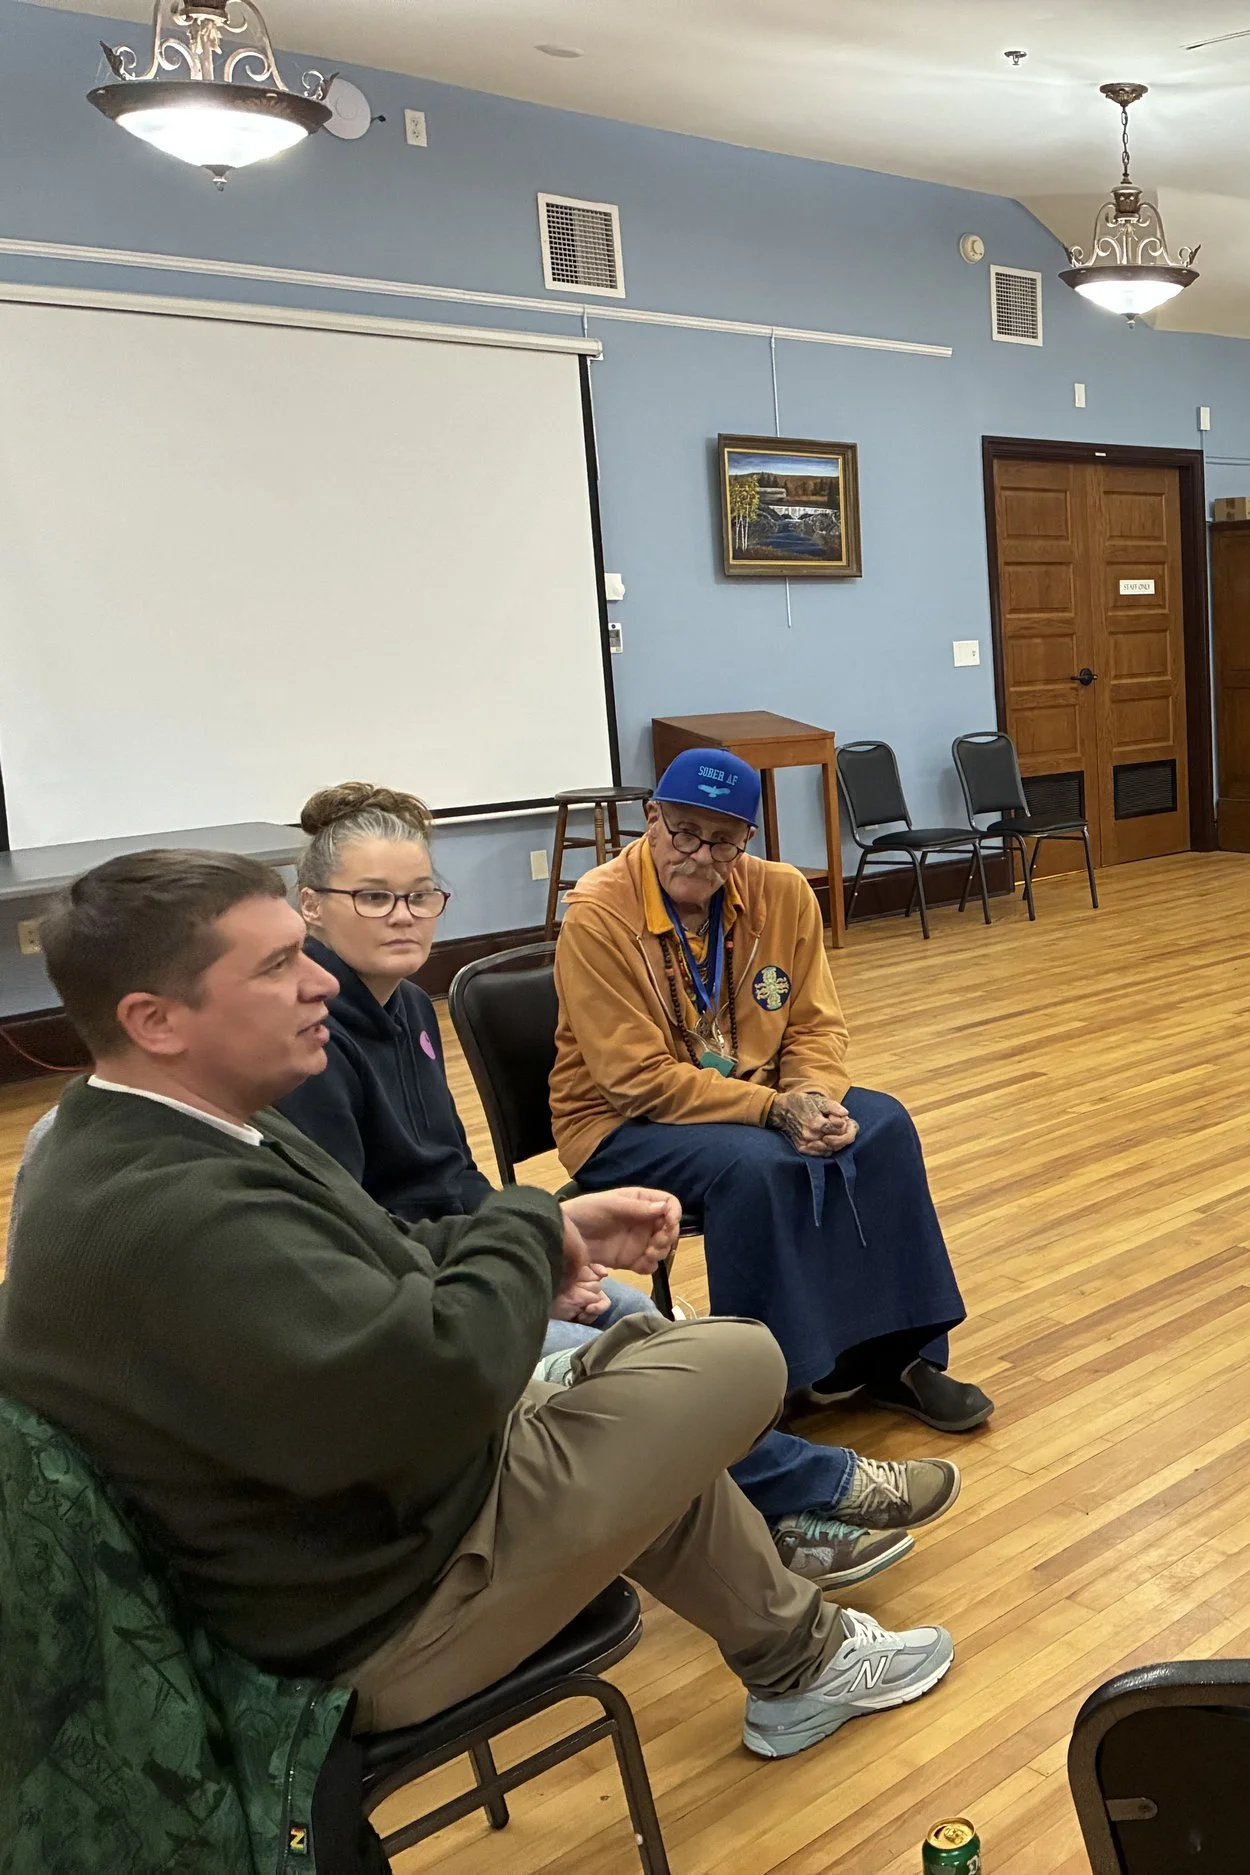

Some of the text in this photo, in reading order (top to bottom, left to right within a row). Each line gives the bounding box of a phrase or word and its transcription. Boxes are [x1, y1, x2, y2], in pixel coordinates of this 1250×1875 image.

[1123, 583, 1150, 591] STAFF ONLY
[698, 765, 738, 786] SOBER AF
[848, 1655, 888, 1693] N
